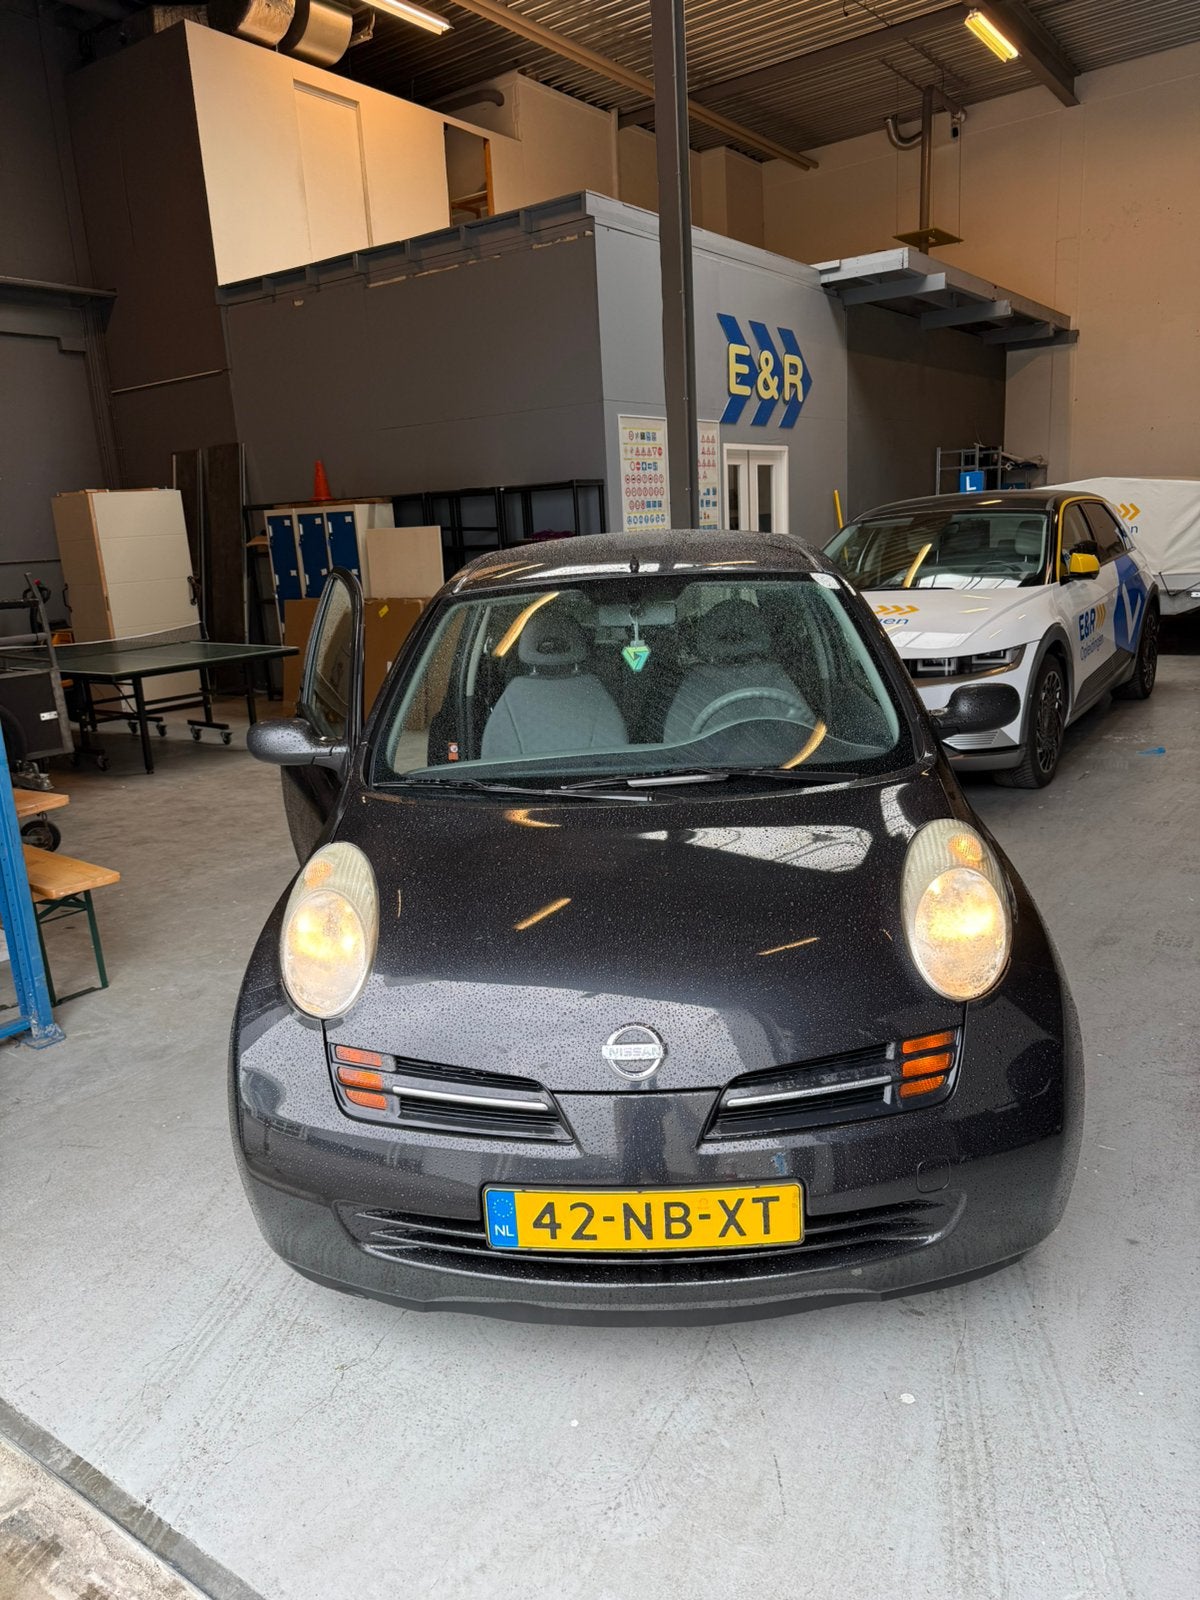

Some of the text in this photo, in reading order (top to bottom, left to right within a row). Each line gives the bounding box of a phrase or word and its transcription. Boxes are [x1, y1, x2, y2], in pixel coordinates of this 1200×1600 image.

[728, 343, 803, 402] E&R
[966, 476, 977, 491] L
[1079, 607, 1096, 641] E&R
[608, 1046, 661, 1058] NISSAN
[532, 1195, 781, 1241] 42-NB-XT
[494, 1224, 515, 1238] NL
